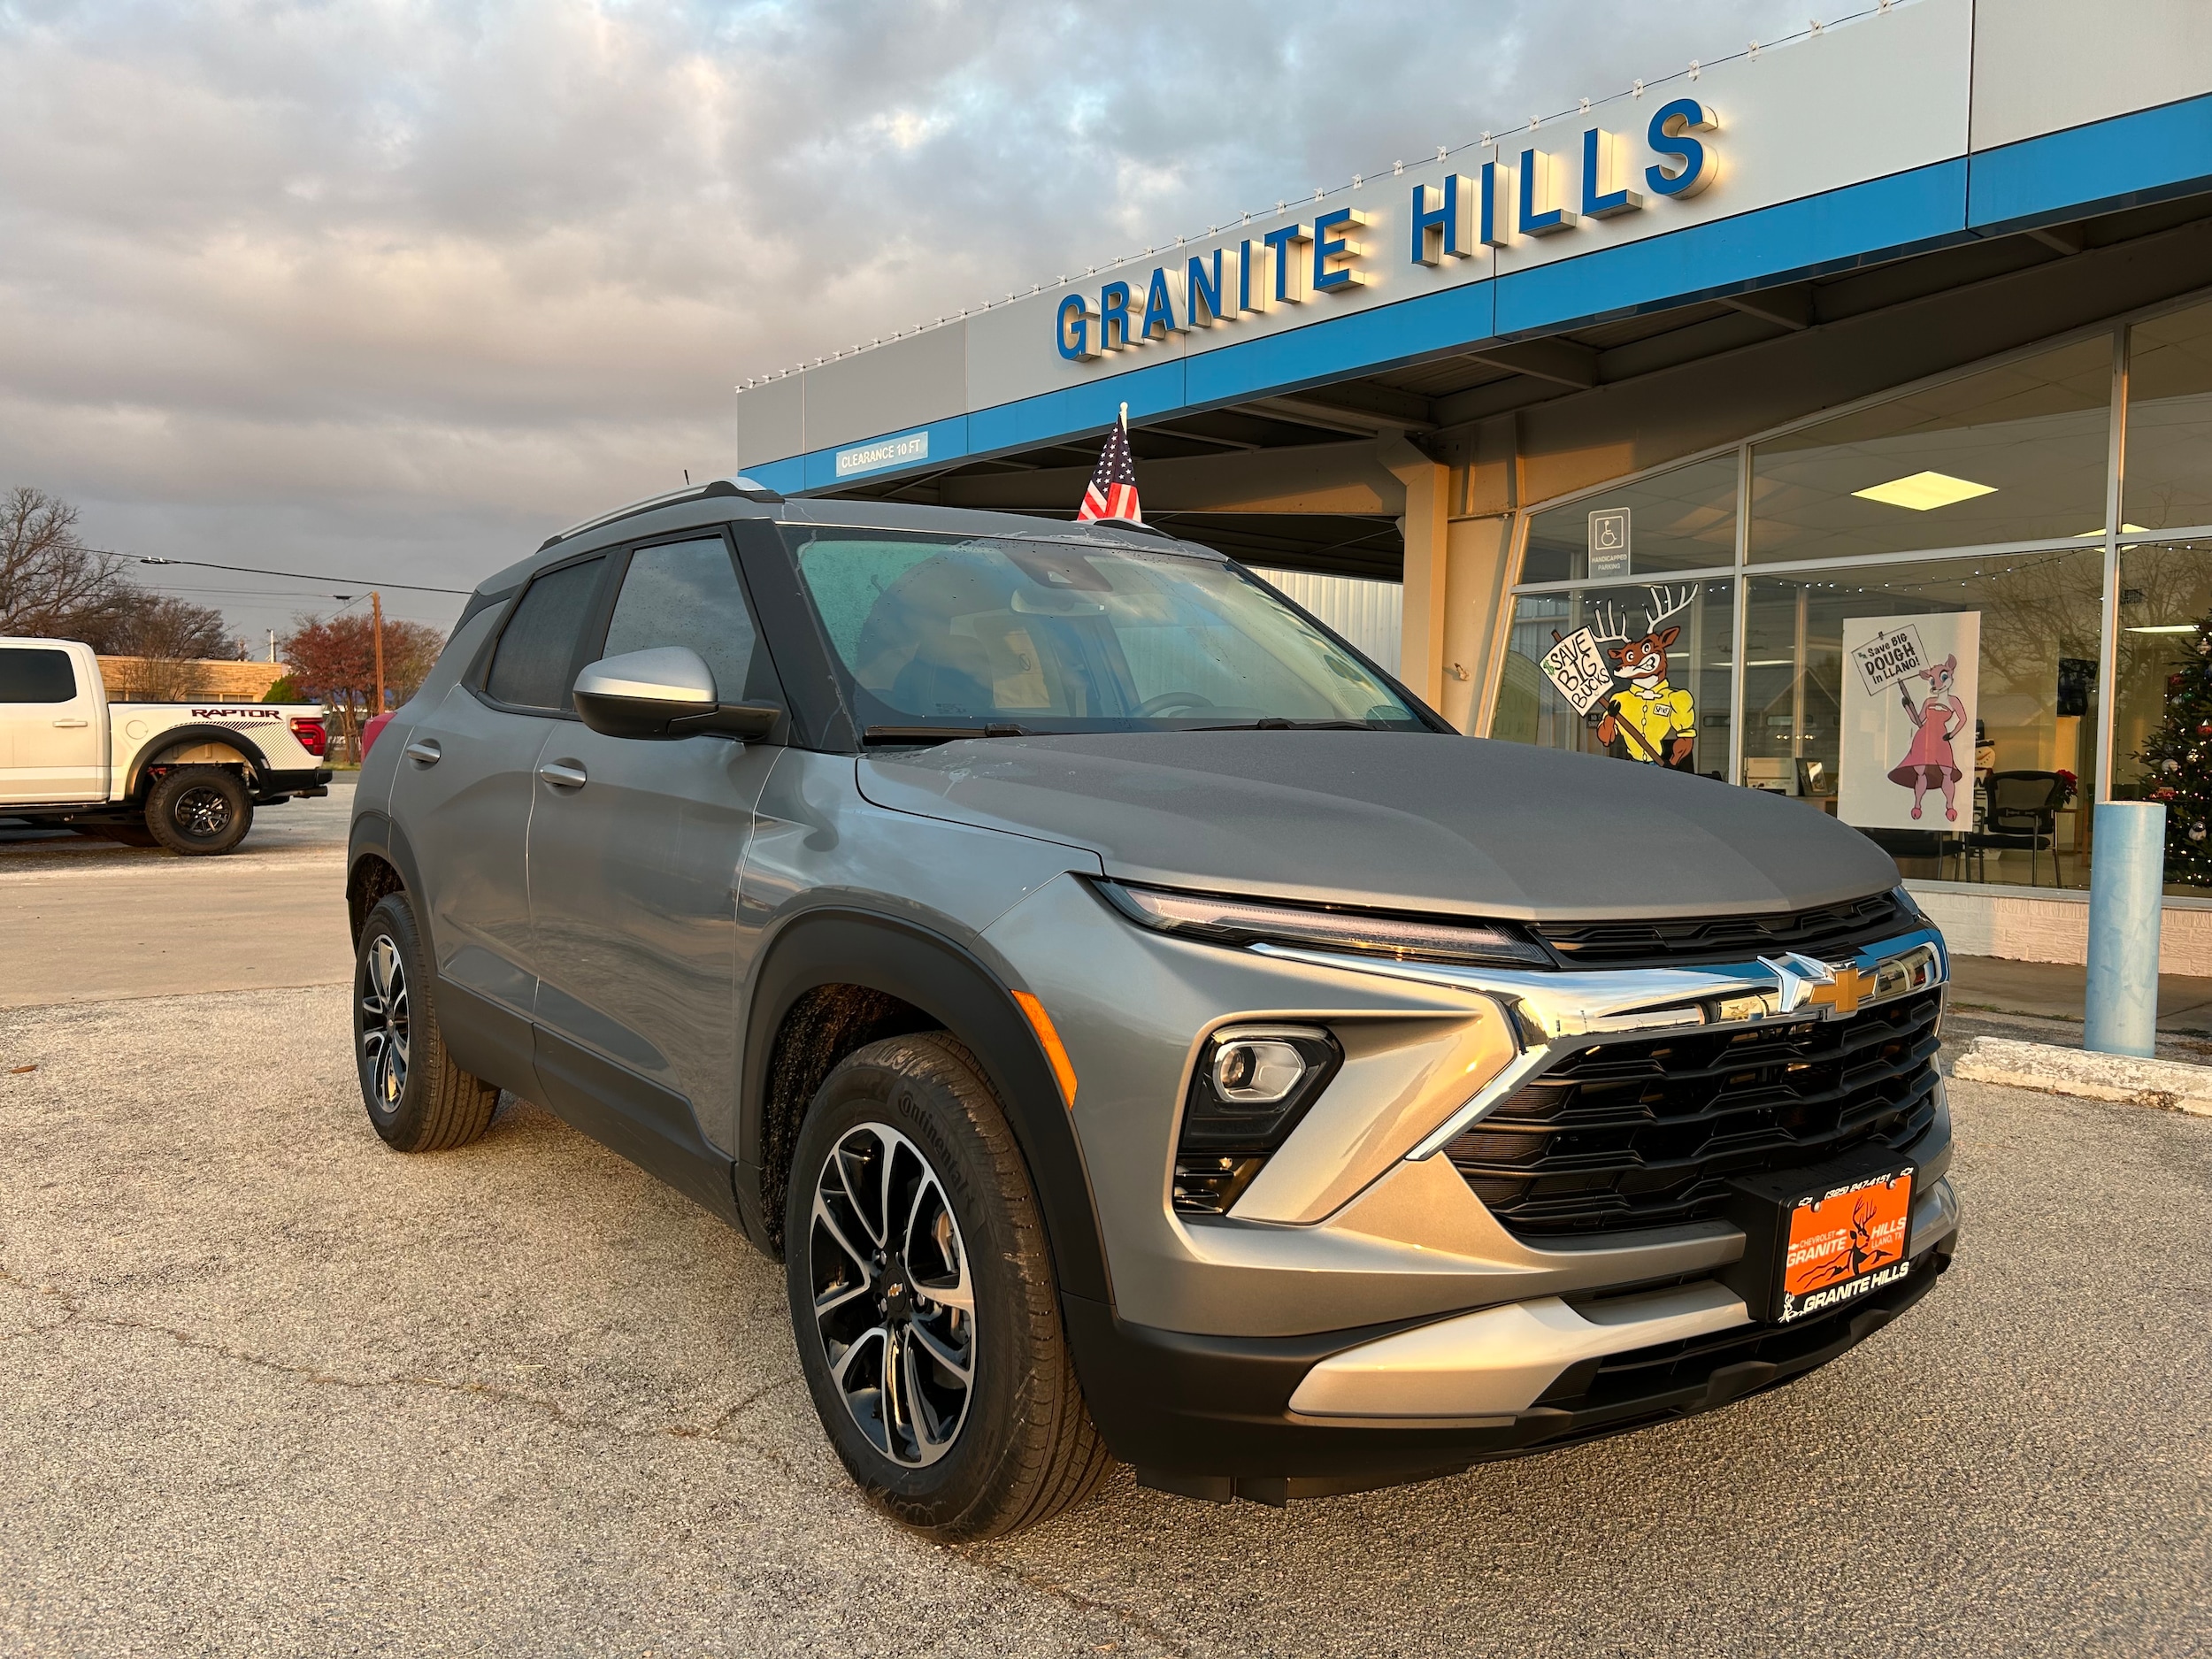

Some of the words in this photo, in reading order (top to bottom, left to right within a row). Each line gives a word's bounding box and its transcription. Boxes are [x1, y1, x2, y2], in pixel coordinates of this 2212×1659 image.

[1056, 207, 1365, 362] GRANITE
[1411, 97, 1717, 267] HILLS
[841, 445, 895, 469] CLEARANCE
[896, 443, 907, 456] 10
[909, 439, 921, 454] FT
[1591, 554, 1627, 564] HANDICAPPED
[1550, 632, 1592, 670] SAVE
[1864, 641, 1916, 676] DOUGH
[1867, 643, 1891, 657] Save
[1892, 633, 1908, 647] BIG
[1557, 654, 1596, 692] BIG
[1883, 657, 1921, 680] LLANO!
[1571, 668, 1610, 709] BUCKS
[191, 709, 283, 721] RAPTOR
[898, 1090, 970, 1195] Continental
[1824, 1186, 1849, 1200] (325)
[1786, 1236, 1847, 1268] GRANITE
[1870, 1217, 1907, 1240] HILLS
[1799, 1230, 1836, 1249] CHEVROLET
[1893, 1231, 1903, 1240] TX
[1803, 1277, 1870, 1313] GRANITE
[1870, 1261, 1910, 1289] HILLS
